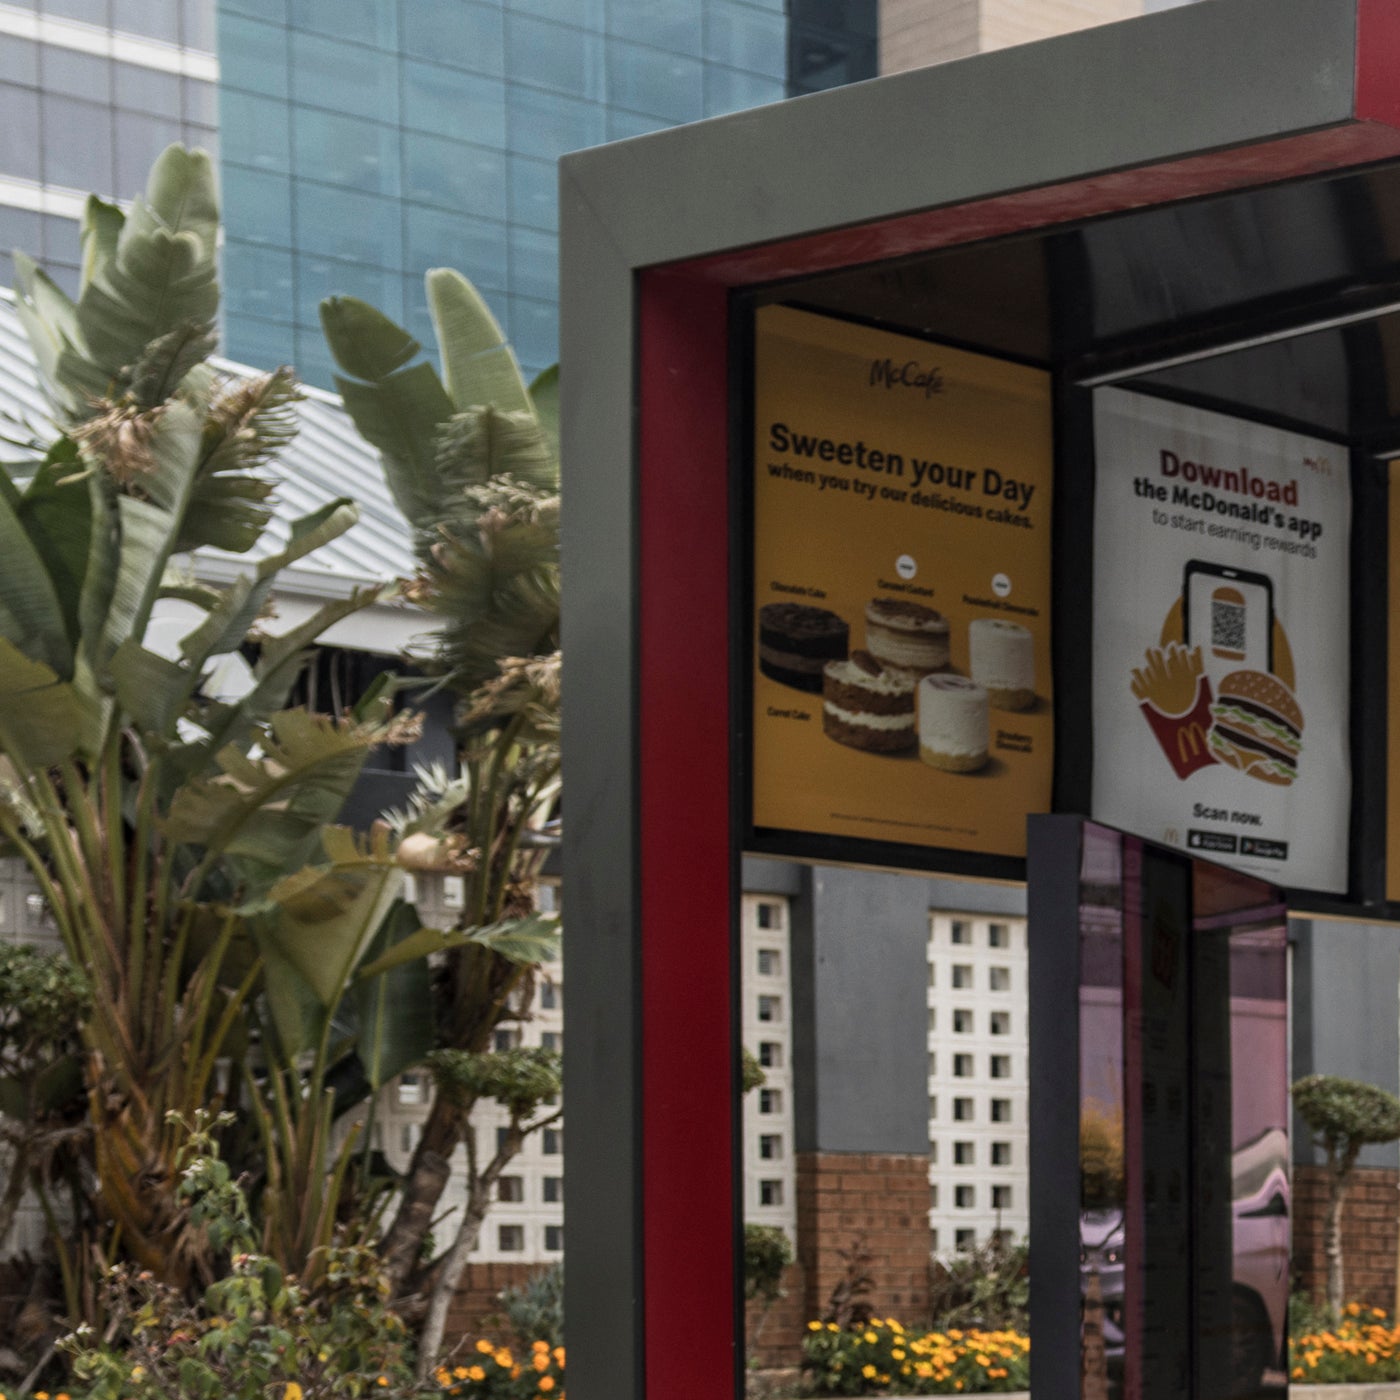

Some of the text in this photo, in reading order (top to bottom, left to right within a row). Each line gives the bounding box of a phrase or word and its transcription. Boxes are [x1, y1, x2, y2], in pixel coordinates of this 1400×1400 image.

[767, 462, 1035, 529] when you try our delicious cakes.
[770, 422, 1036, 511] Sweeten your Day
[1159, 448, 1299, 508] Download
[1133, 477, 1323, 541] the McDonald's app
[1152, 509, 1318, 560] to start earning rewards
[1192, 802, 1263, 826] Scan now.
